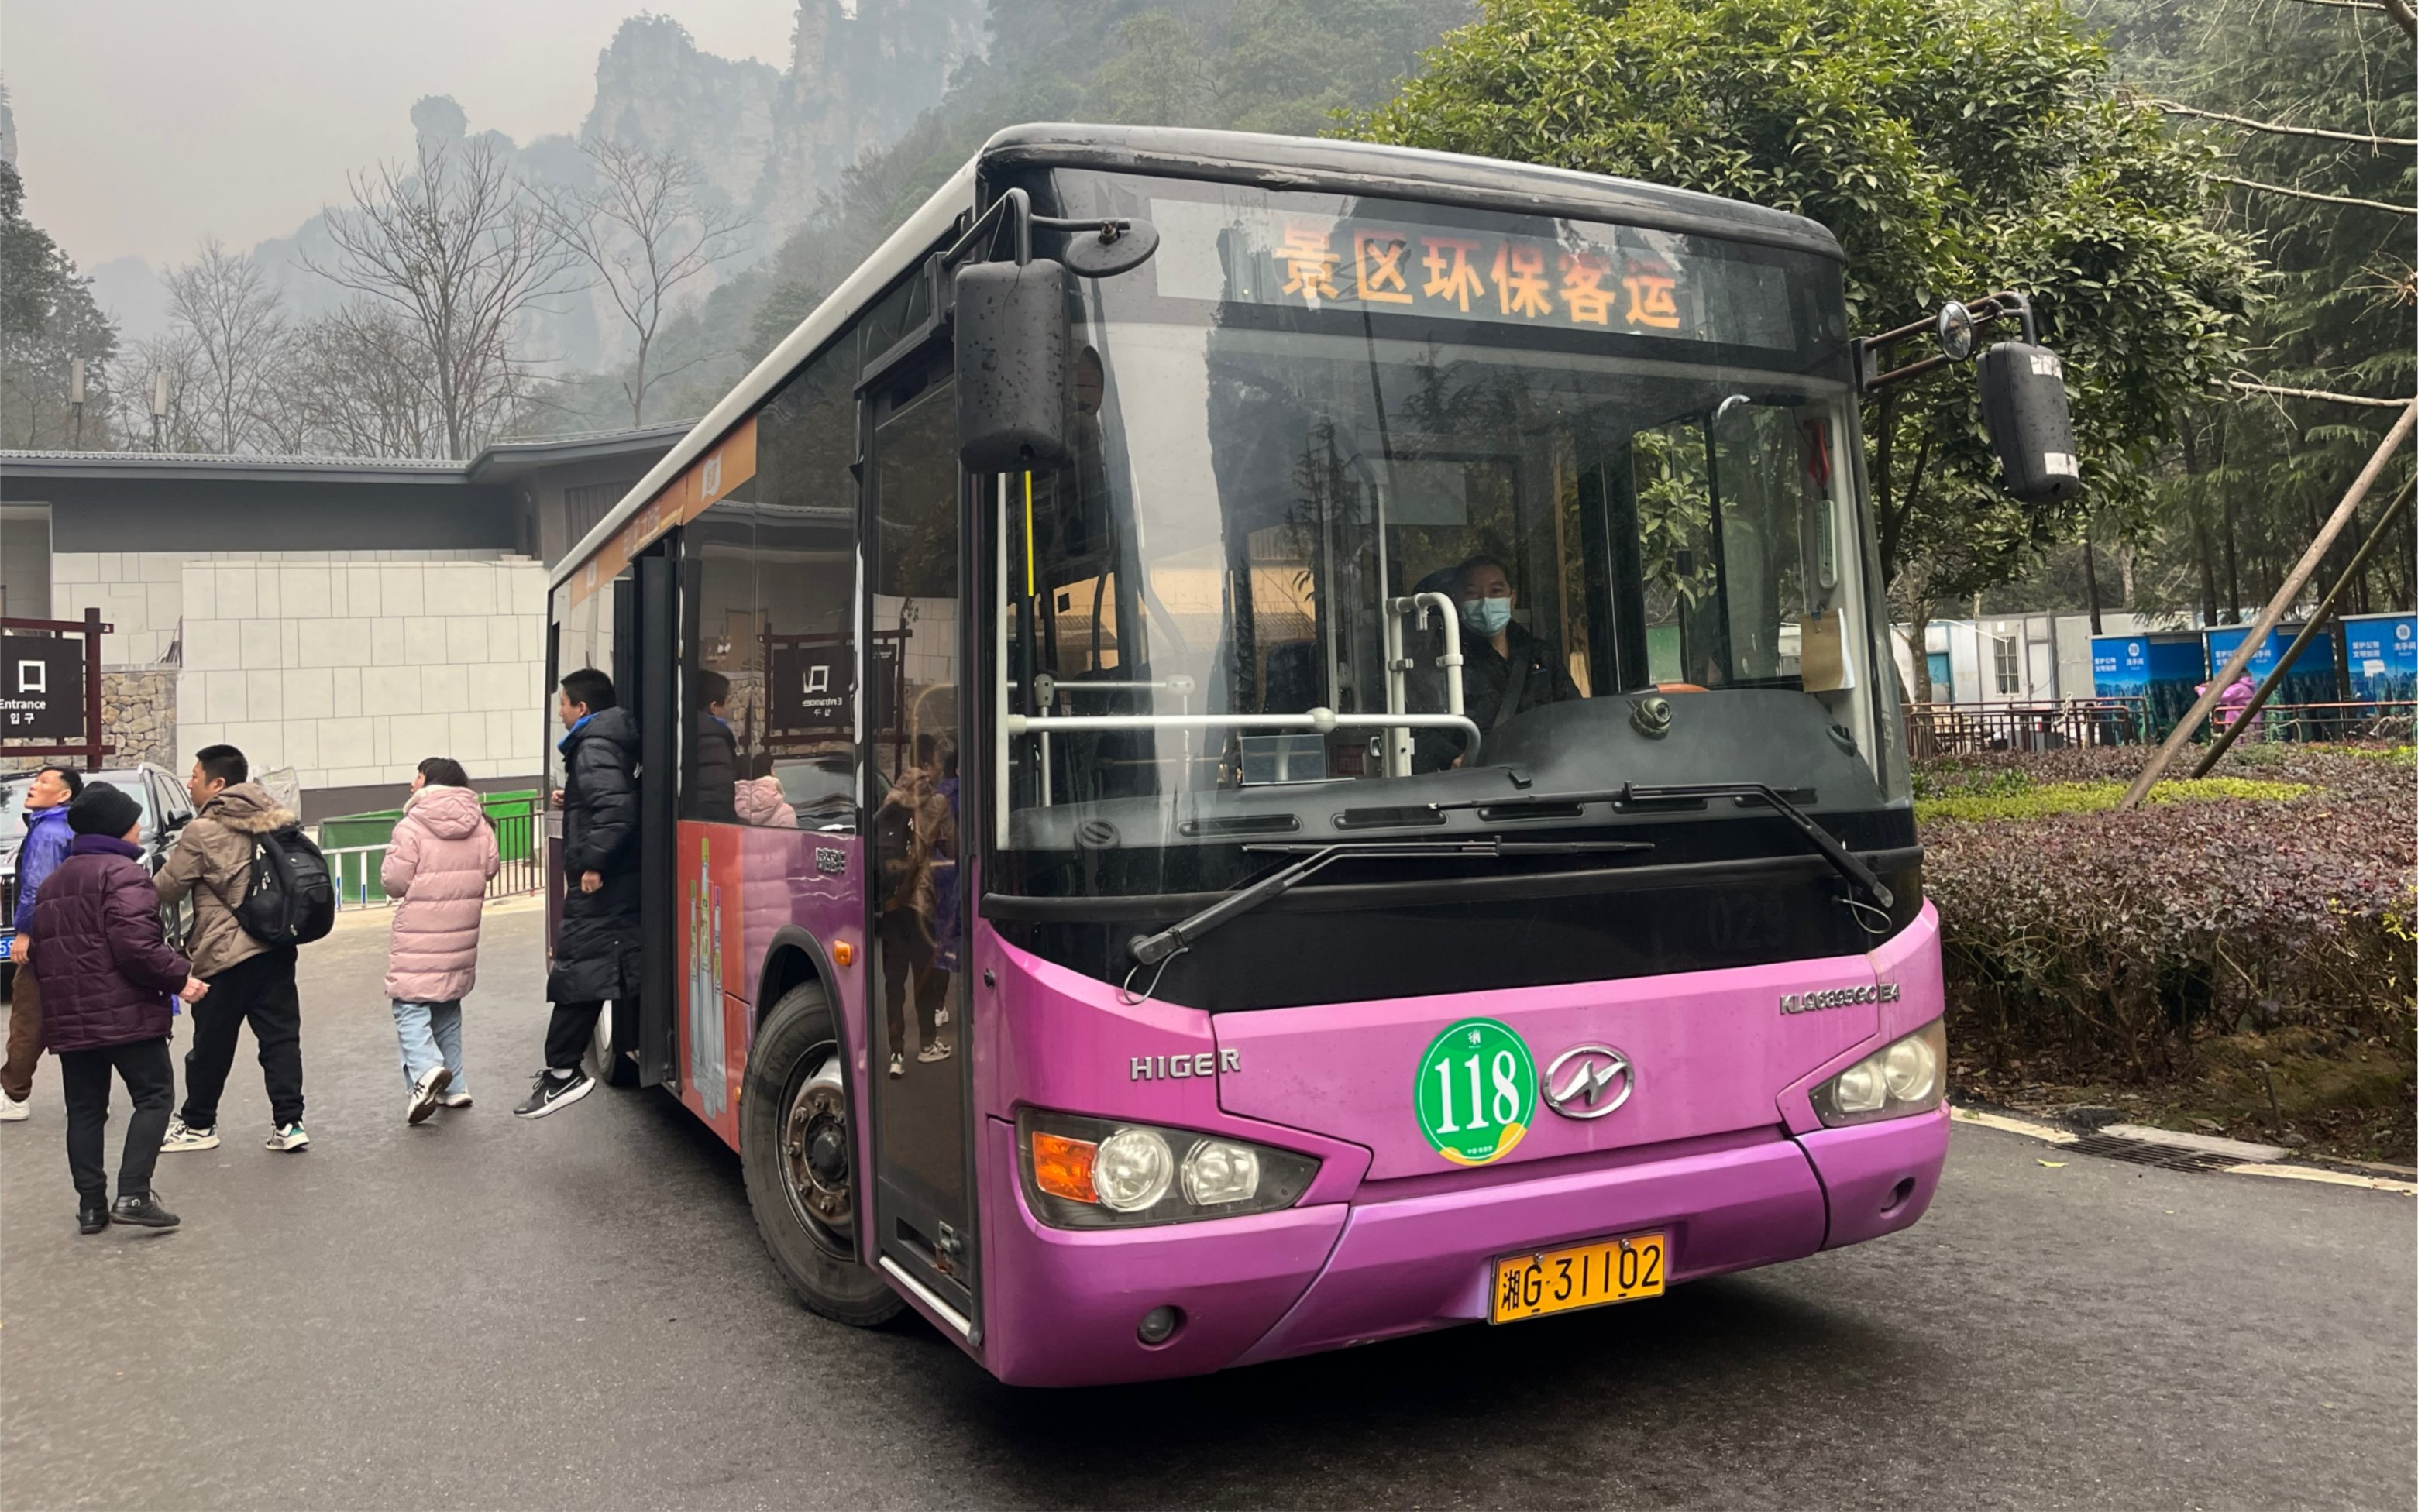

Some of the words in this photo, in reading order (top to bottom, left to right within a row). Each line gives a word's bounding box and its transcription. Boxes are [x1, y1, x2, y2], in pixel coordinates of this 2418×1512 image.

[1275, 229, 1680, 329] 景区环保客运
[0, 699, 46, 710] Entrance
[1130, 1048, 1241, 1081] HIGER
[1435, 1050, 1520, 1134] 118
